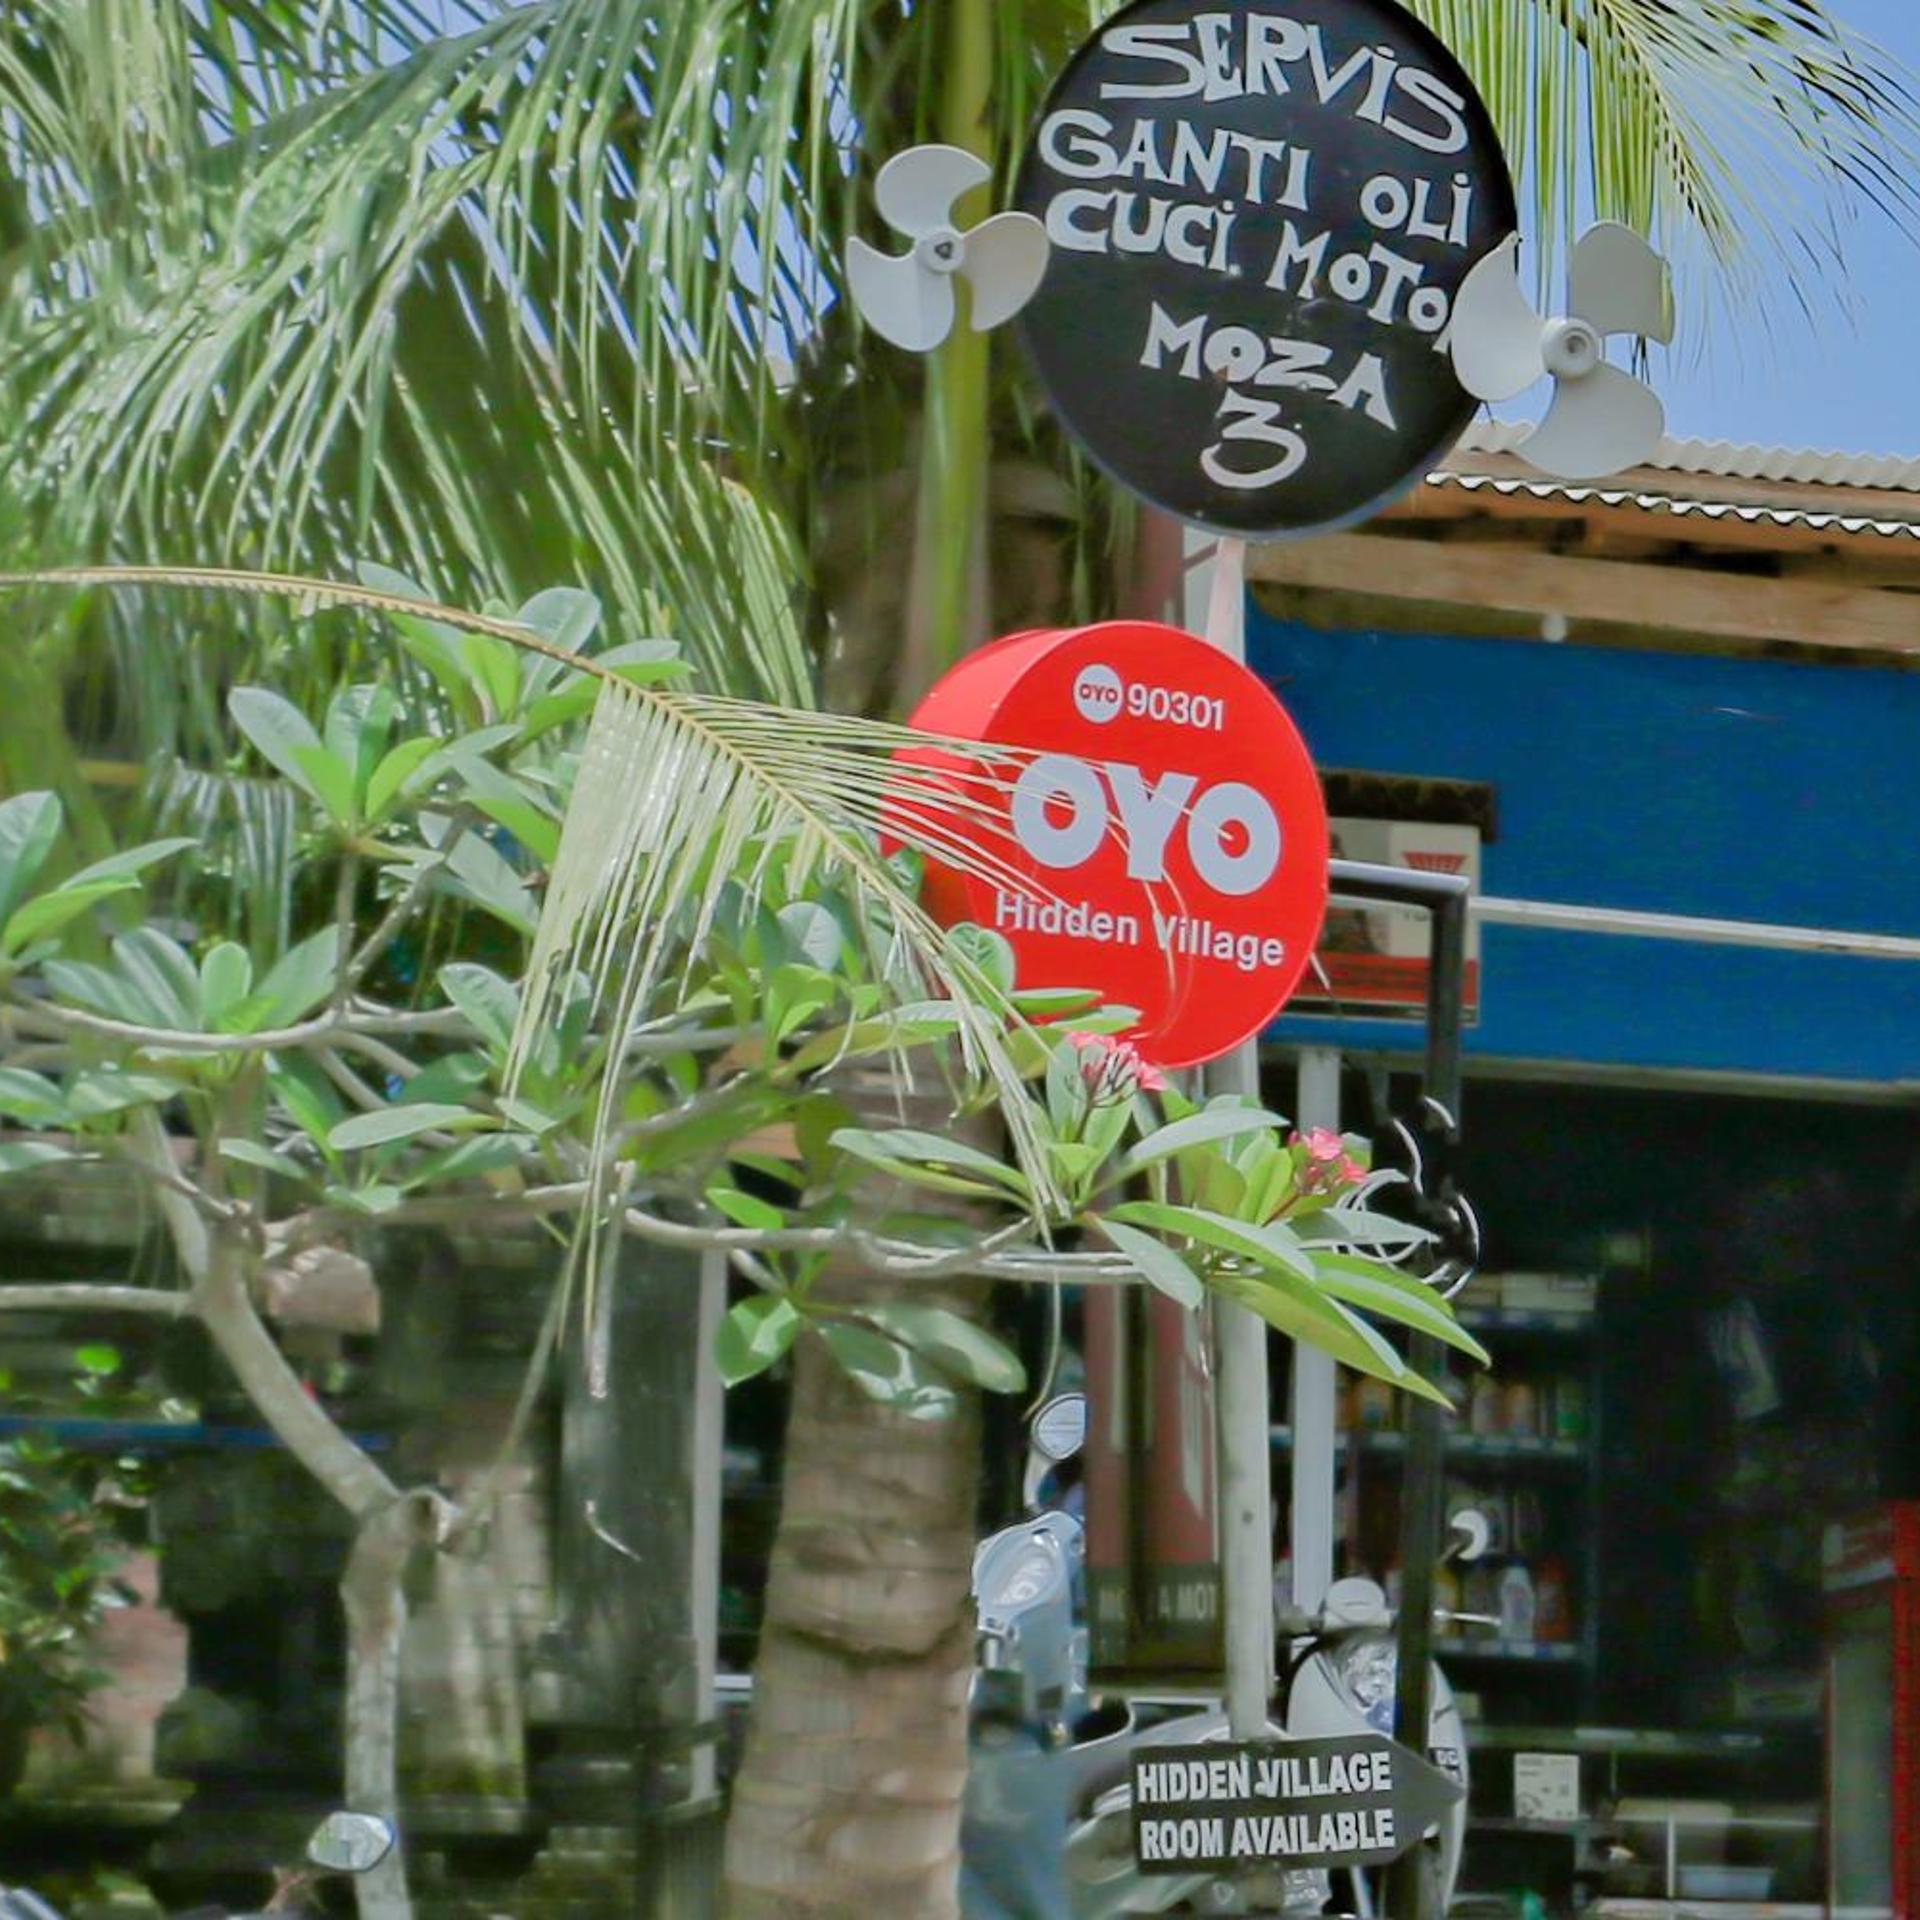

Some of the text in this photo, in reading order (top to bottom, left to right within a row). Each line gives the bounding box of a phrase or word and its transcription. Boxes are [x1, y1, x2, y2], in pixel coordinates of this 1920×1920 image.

[1038, 109, 1313, 211] GANTI
[1265, 220, 1452, 353] MOTO
[1140, 301, 1398, 431] MOZA
[1202, 388, 1308, 489] 3
[1079, 682, 1225, 732] OYO 90301
[1012, 753, 1281, 895] OYO
[996, 889, 1284, 971] Hidden Village
[1137, 1751, 1392, 1802] HIDDEN VILLAGE
[1140, 1808, 1395, 1860] ROOM AVAILABLE
